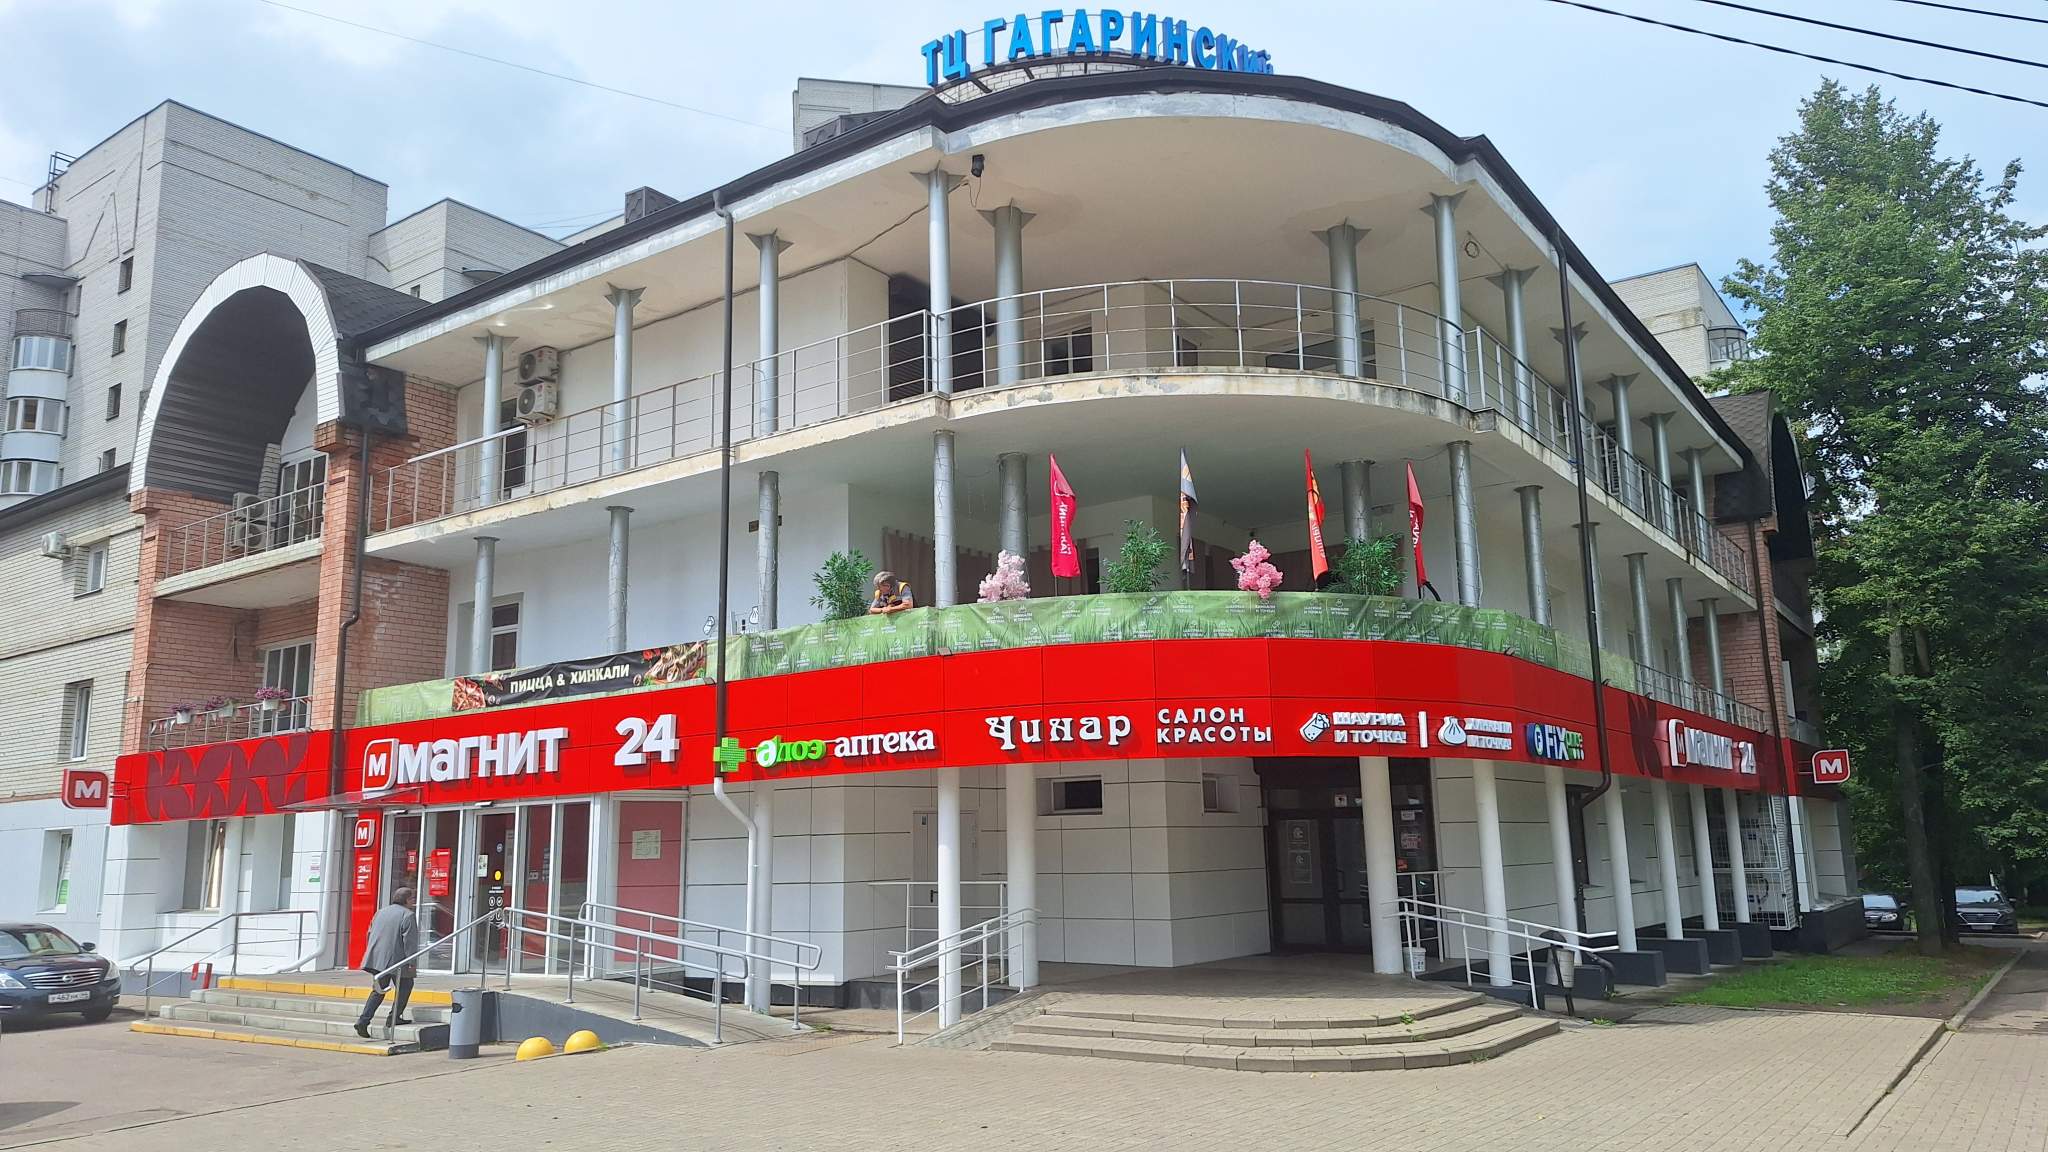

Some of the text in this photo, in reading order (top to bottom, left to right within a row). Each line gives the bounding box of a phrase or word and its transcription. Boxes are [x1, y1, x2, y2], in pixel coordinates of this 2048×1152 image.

[921, 9, 1274, 87] ТЦ ГАГАРИНСКИЙ
[510, 663, 630, 694] ПИЦЦА & ХИНКАЛИ
[1158, 707, 1245, 724] САЛОН
[1333, 711, 1406, 726] ШАУРМА
[614, 713, 680, 766] 24
[834, 729, 936, 758] аптека
[985, 714, 1131, 750] Чинар
[1156, 725, 1272, 743] КРАСОТЫ
[1334, 729, 1407, 744] И ТОЧКА!
[1738, 741, 1757, 775] 24
